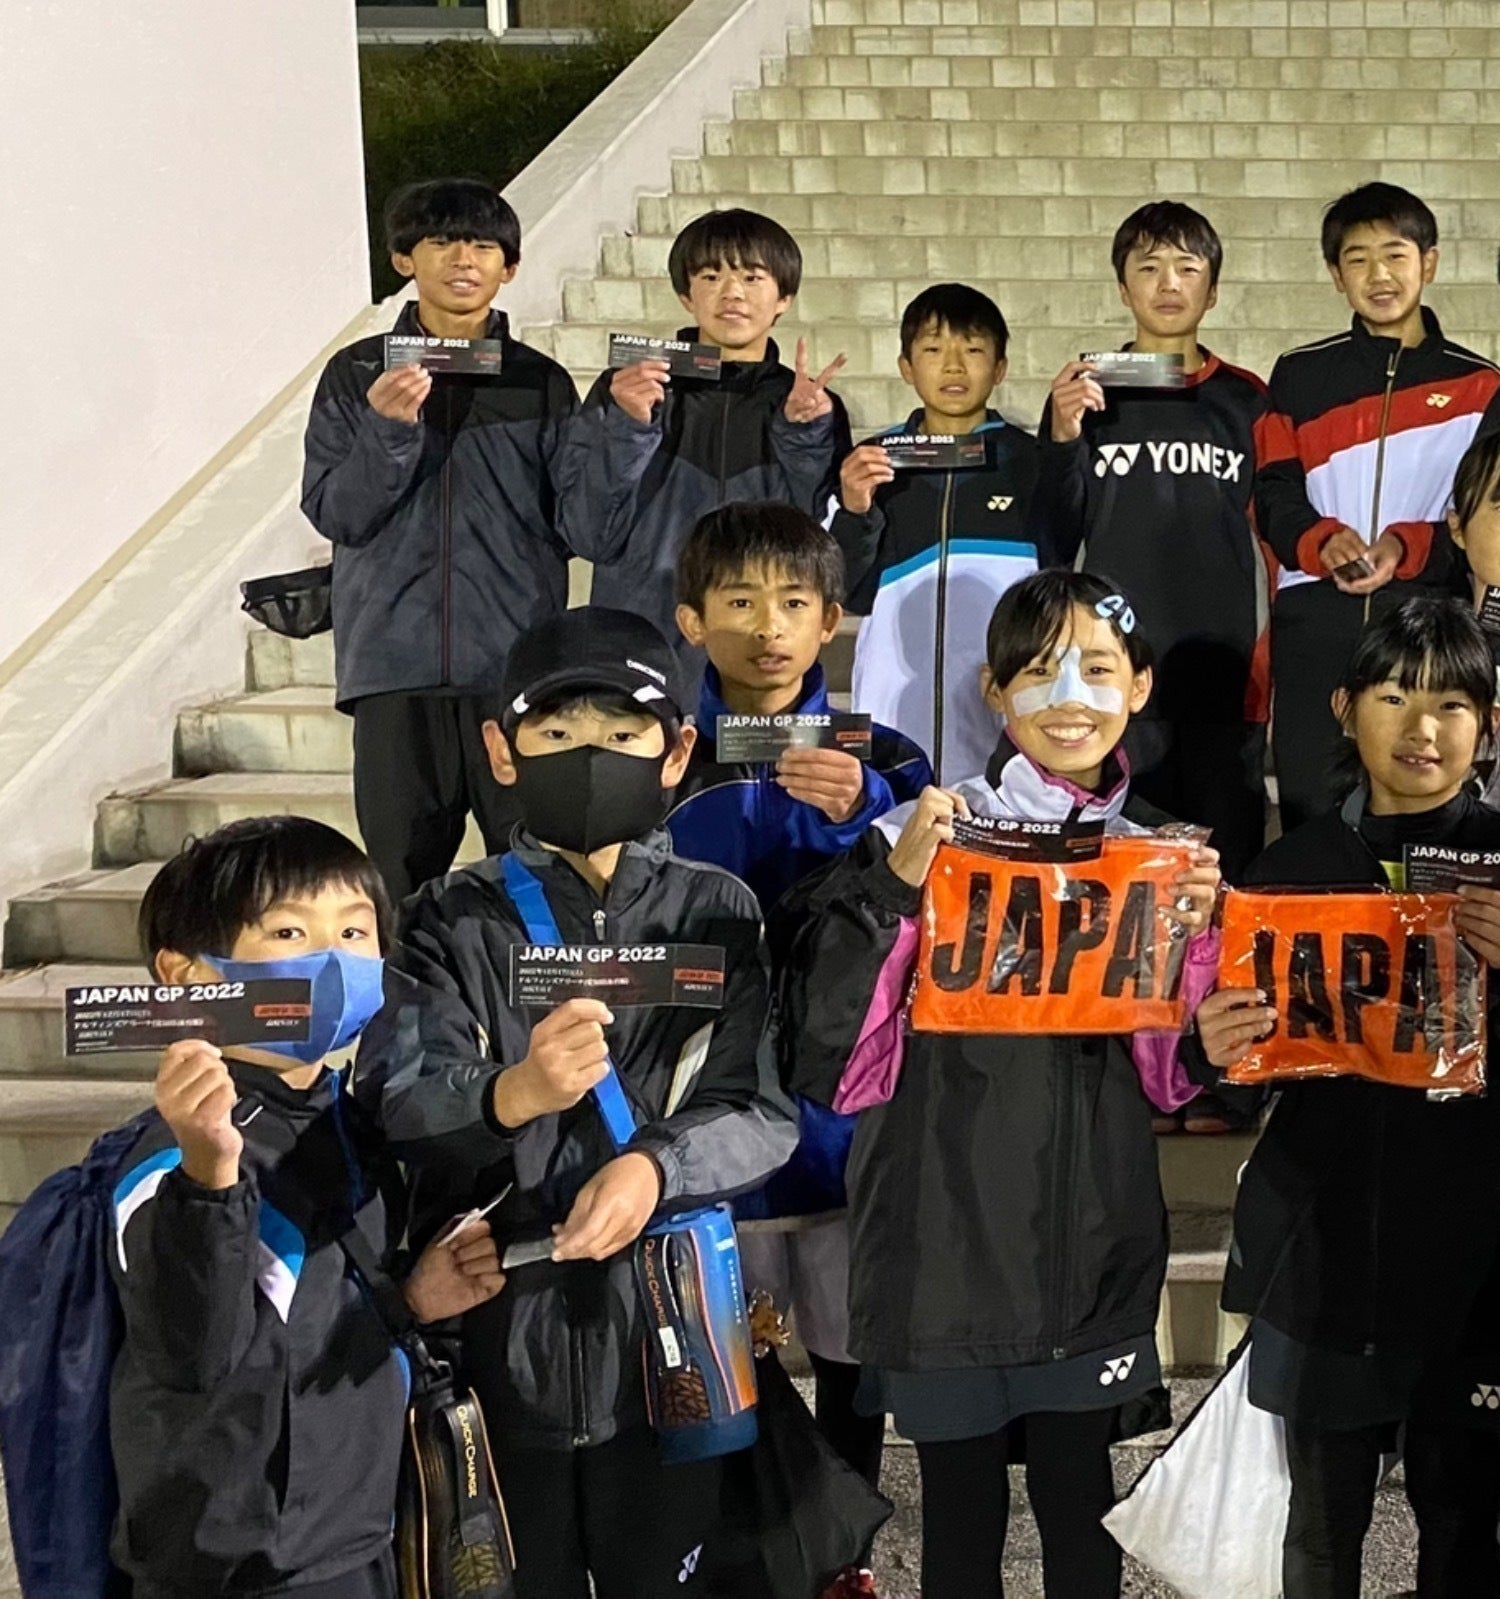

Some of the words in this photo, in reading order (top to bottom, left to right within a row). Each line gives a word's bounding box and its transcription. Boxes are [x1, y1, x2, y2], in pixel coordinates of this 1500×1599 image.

[389, 336, 425, 346] JAPAN
[614, 334, 647, 345] JAPAN
[649, 339, 663, 348] GP
[664, 340, 692, 353] 2022
[881, 435, 914, 446] JAPAN
[1147, 441, 1245, 483] YONEX
[723, 715, 770, 728] JAPAN
[773, 715, 792, 727] GP
[796, 715, 831, 727] 2022
[997, 822, 1019, 832] GP
[1022, 823, 1061, 834] 2022
[1410, 846, 1457, 861] JAPAN
[1460, 853, 1480, 865] GP
[931, 872, 1187, 1000] JAPA
[519, 946, 582, 962] JAPAN
[587, 948, 613, 963] GP
[617, 946, 667, 962] 2022
[73, 986, 149, 1006] JAPAN
[154, 985, 184, 1003] GP
[189, 982, 245, 1001] 2022
